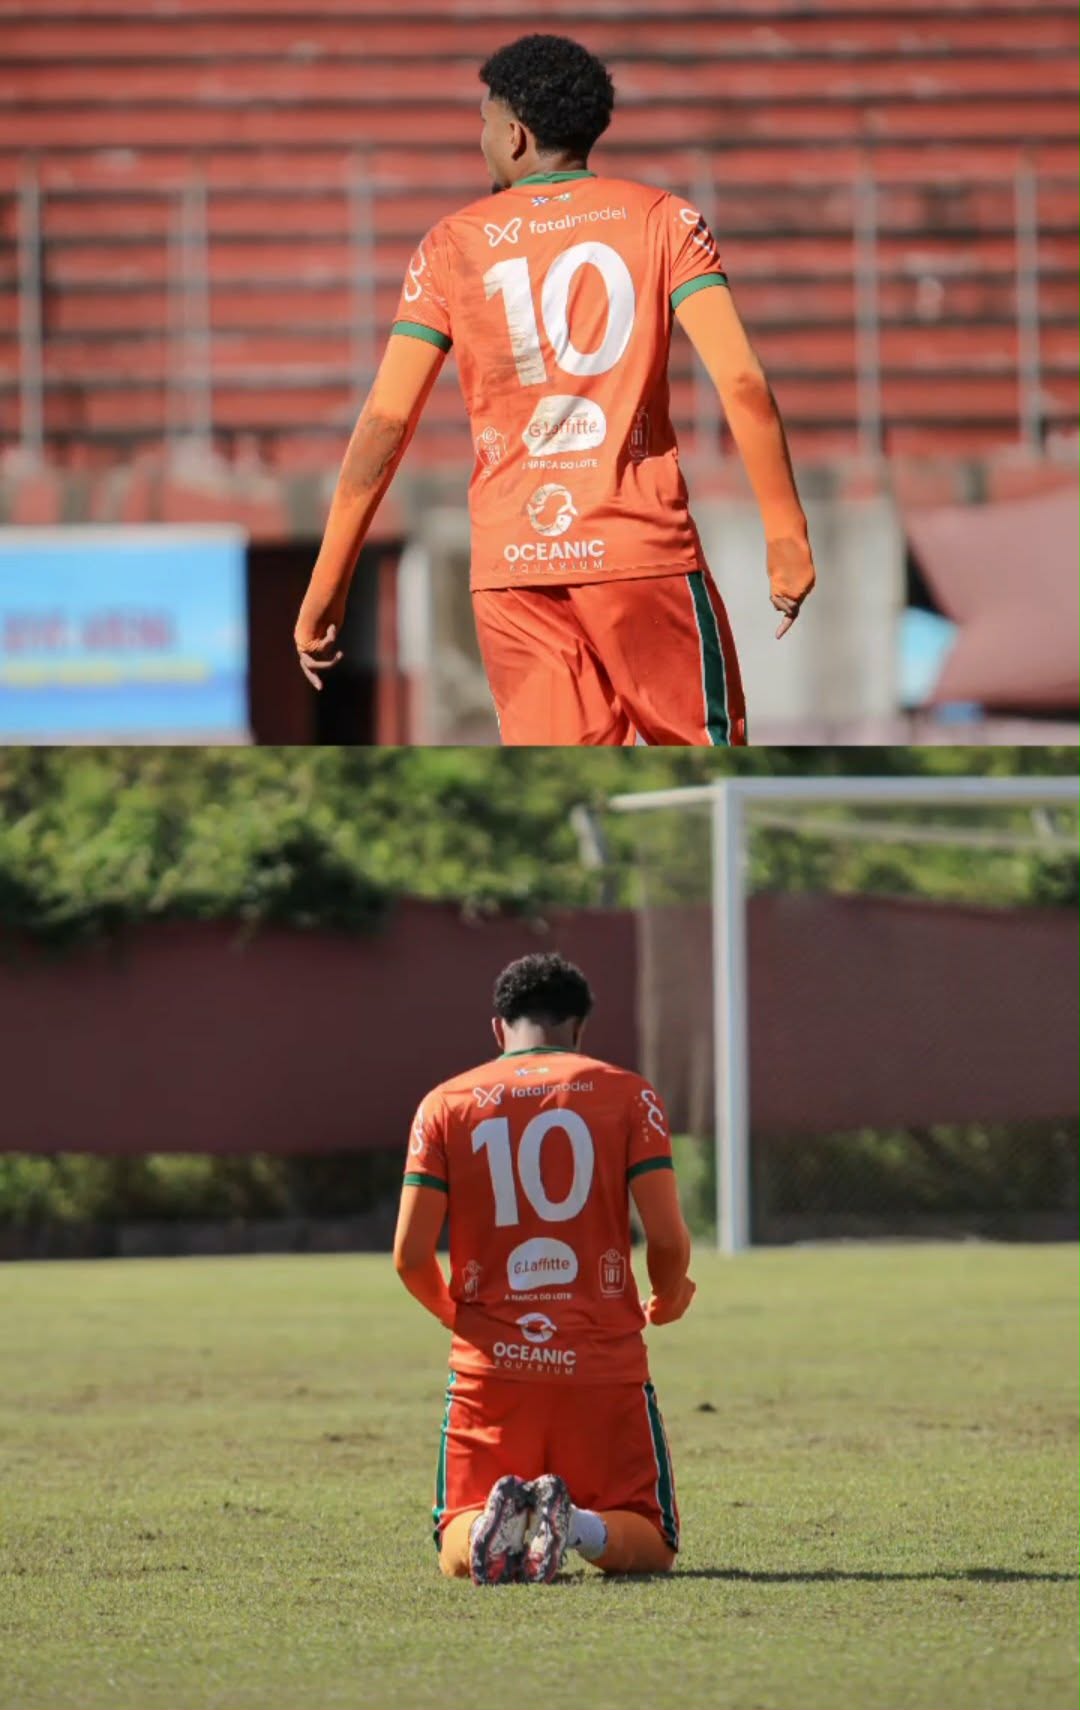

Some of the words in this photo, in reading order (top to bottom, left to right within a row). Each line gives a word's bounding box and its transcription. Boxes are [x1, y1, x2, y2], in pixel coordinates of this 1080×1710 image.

[529, 206, 628, 234] fatalmodel
[483, 241, 636, 387] 10
[529, 418, 598, 438] G.Lafitte
[560, 460, 575, 470] DO
[575, 458, 598, 469] LOTE
[503, 539, 606, 562] OCEANIC
[511, 1080, 593, 1098] fatalmodel
[471, 1108, 594, 1227] 10
[514, 1256, 570, 1274] G.Laffitte
[493, 1341, 577, 1366] OCEANIC
